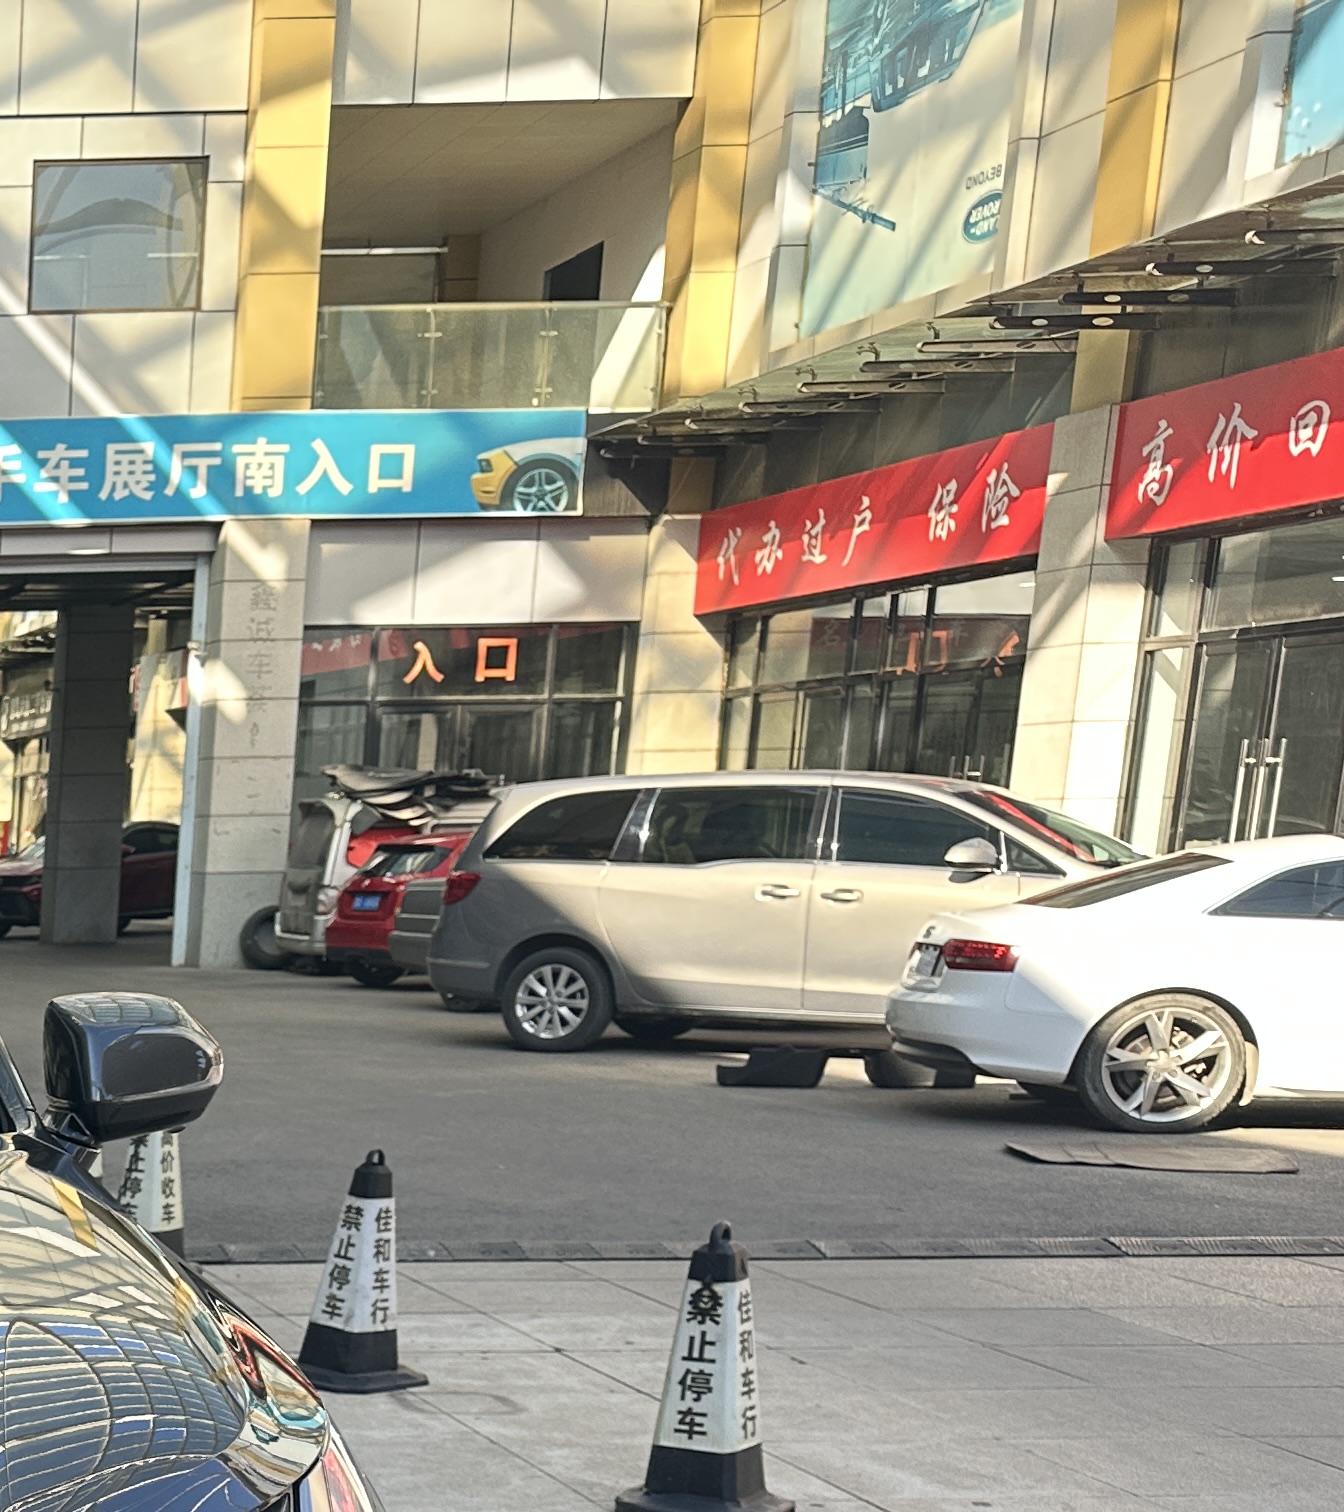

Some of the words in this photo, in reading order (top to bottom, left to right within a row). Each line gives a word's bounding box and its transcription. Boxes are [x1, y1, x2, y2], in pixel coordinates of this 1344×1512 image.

[1138, 400, 1330, 506] 高价回
[717, 496, 872, 586] 代办过户
[928, 462, 1020, 542] 保险
[403, 637, 518, 684] 入口
[321, 1204, 364, 1320] 禁止停车
[370, 1206, 393, 1324] 佳和车行
[673, 1281, 724, 1440] 禁止停车
[737, 1289, 757, 1440] 佳和车行
